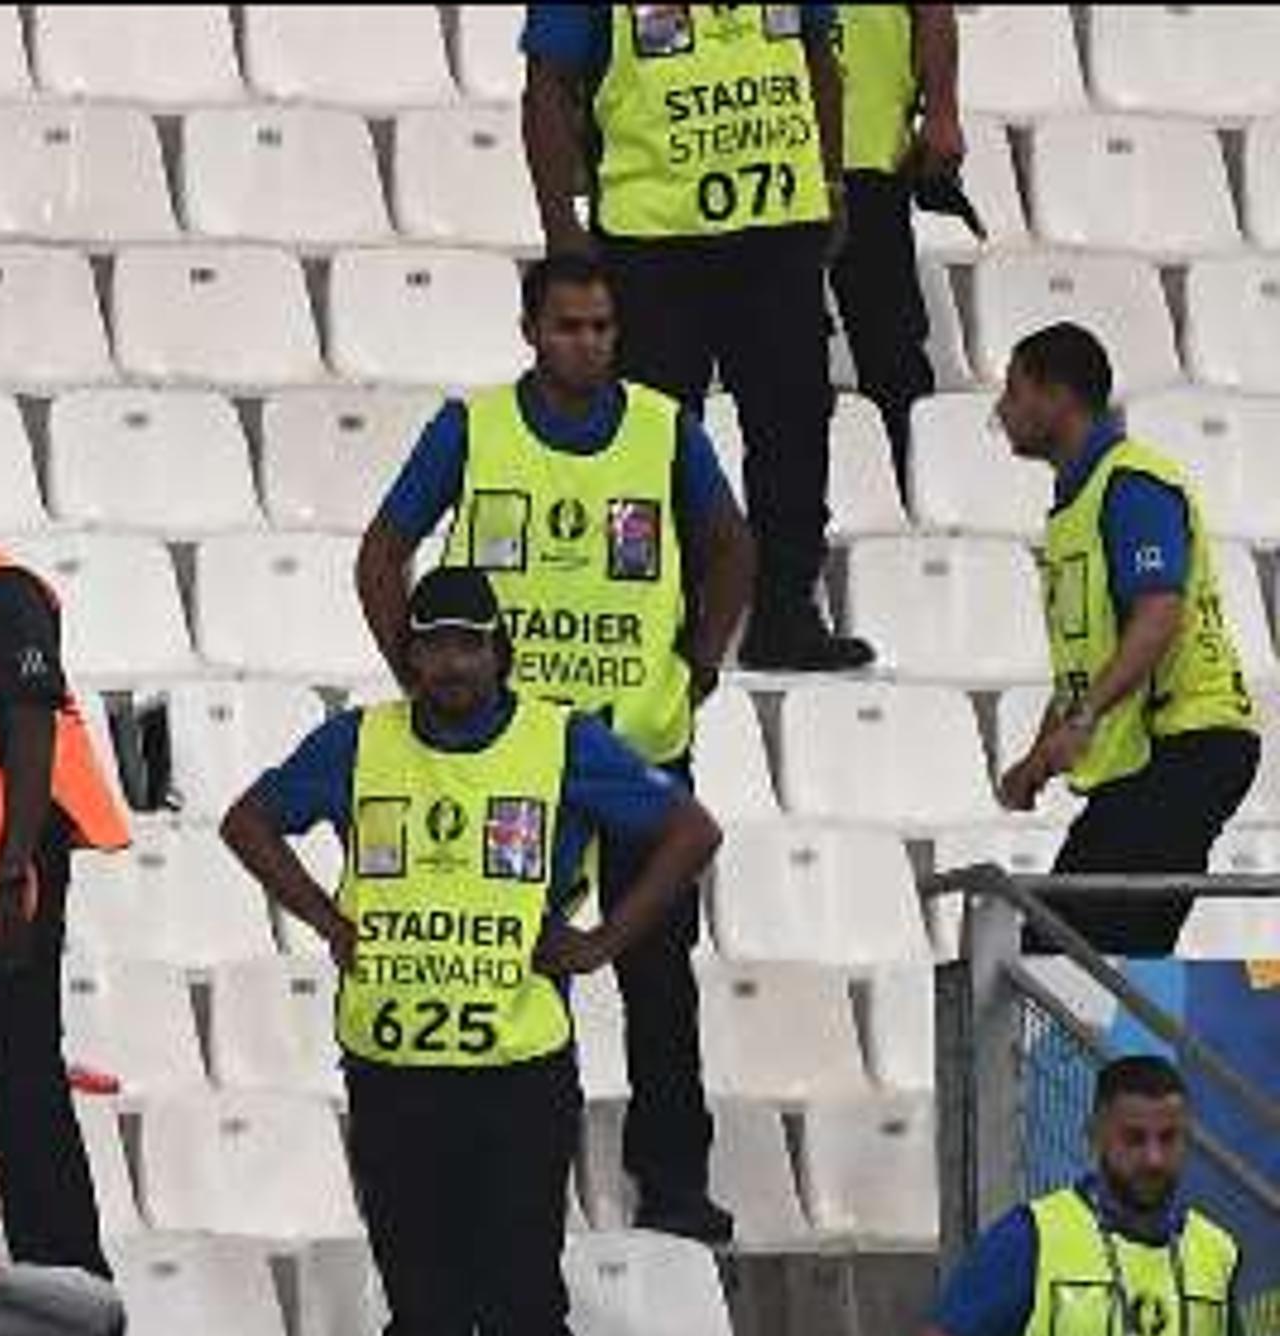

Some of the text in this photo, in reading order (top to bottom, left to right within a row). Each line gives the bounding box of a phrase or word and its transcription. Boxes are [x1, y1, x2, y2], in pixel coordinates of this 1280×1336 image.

[504, 609, 642, 645] TADIER
[357, 910, 523, 948] STADIER
[373, 1000, 498, 1054] 625
